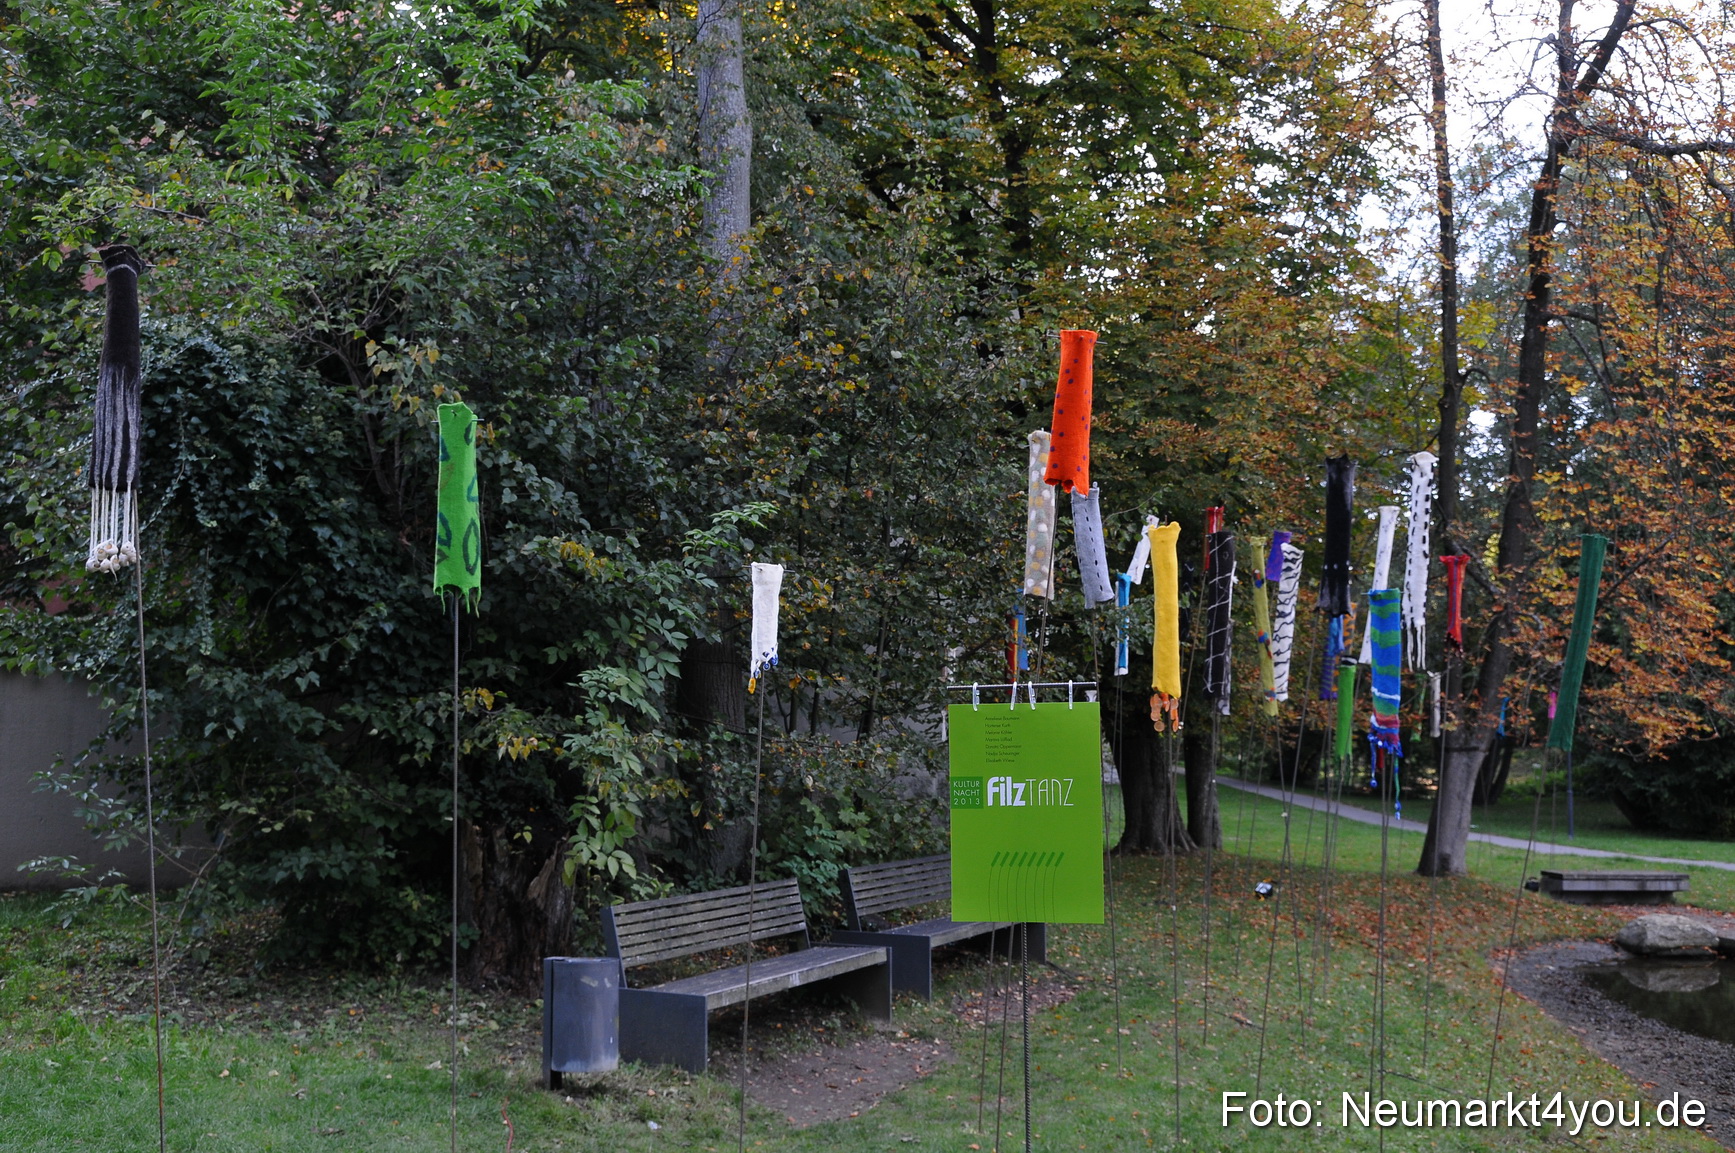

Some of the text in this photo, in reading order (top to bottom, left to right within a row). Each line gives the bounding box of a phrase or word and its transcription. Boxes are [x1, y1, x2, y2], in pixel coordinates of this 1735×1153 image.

[953, 780, 980, 788] KULTUR
[953, 789, 980, 797] NACHT
[953, 798, 980, 806] 2013
